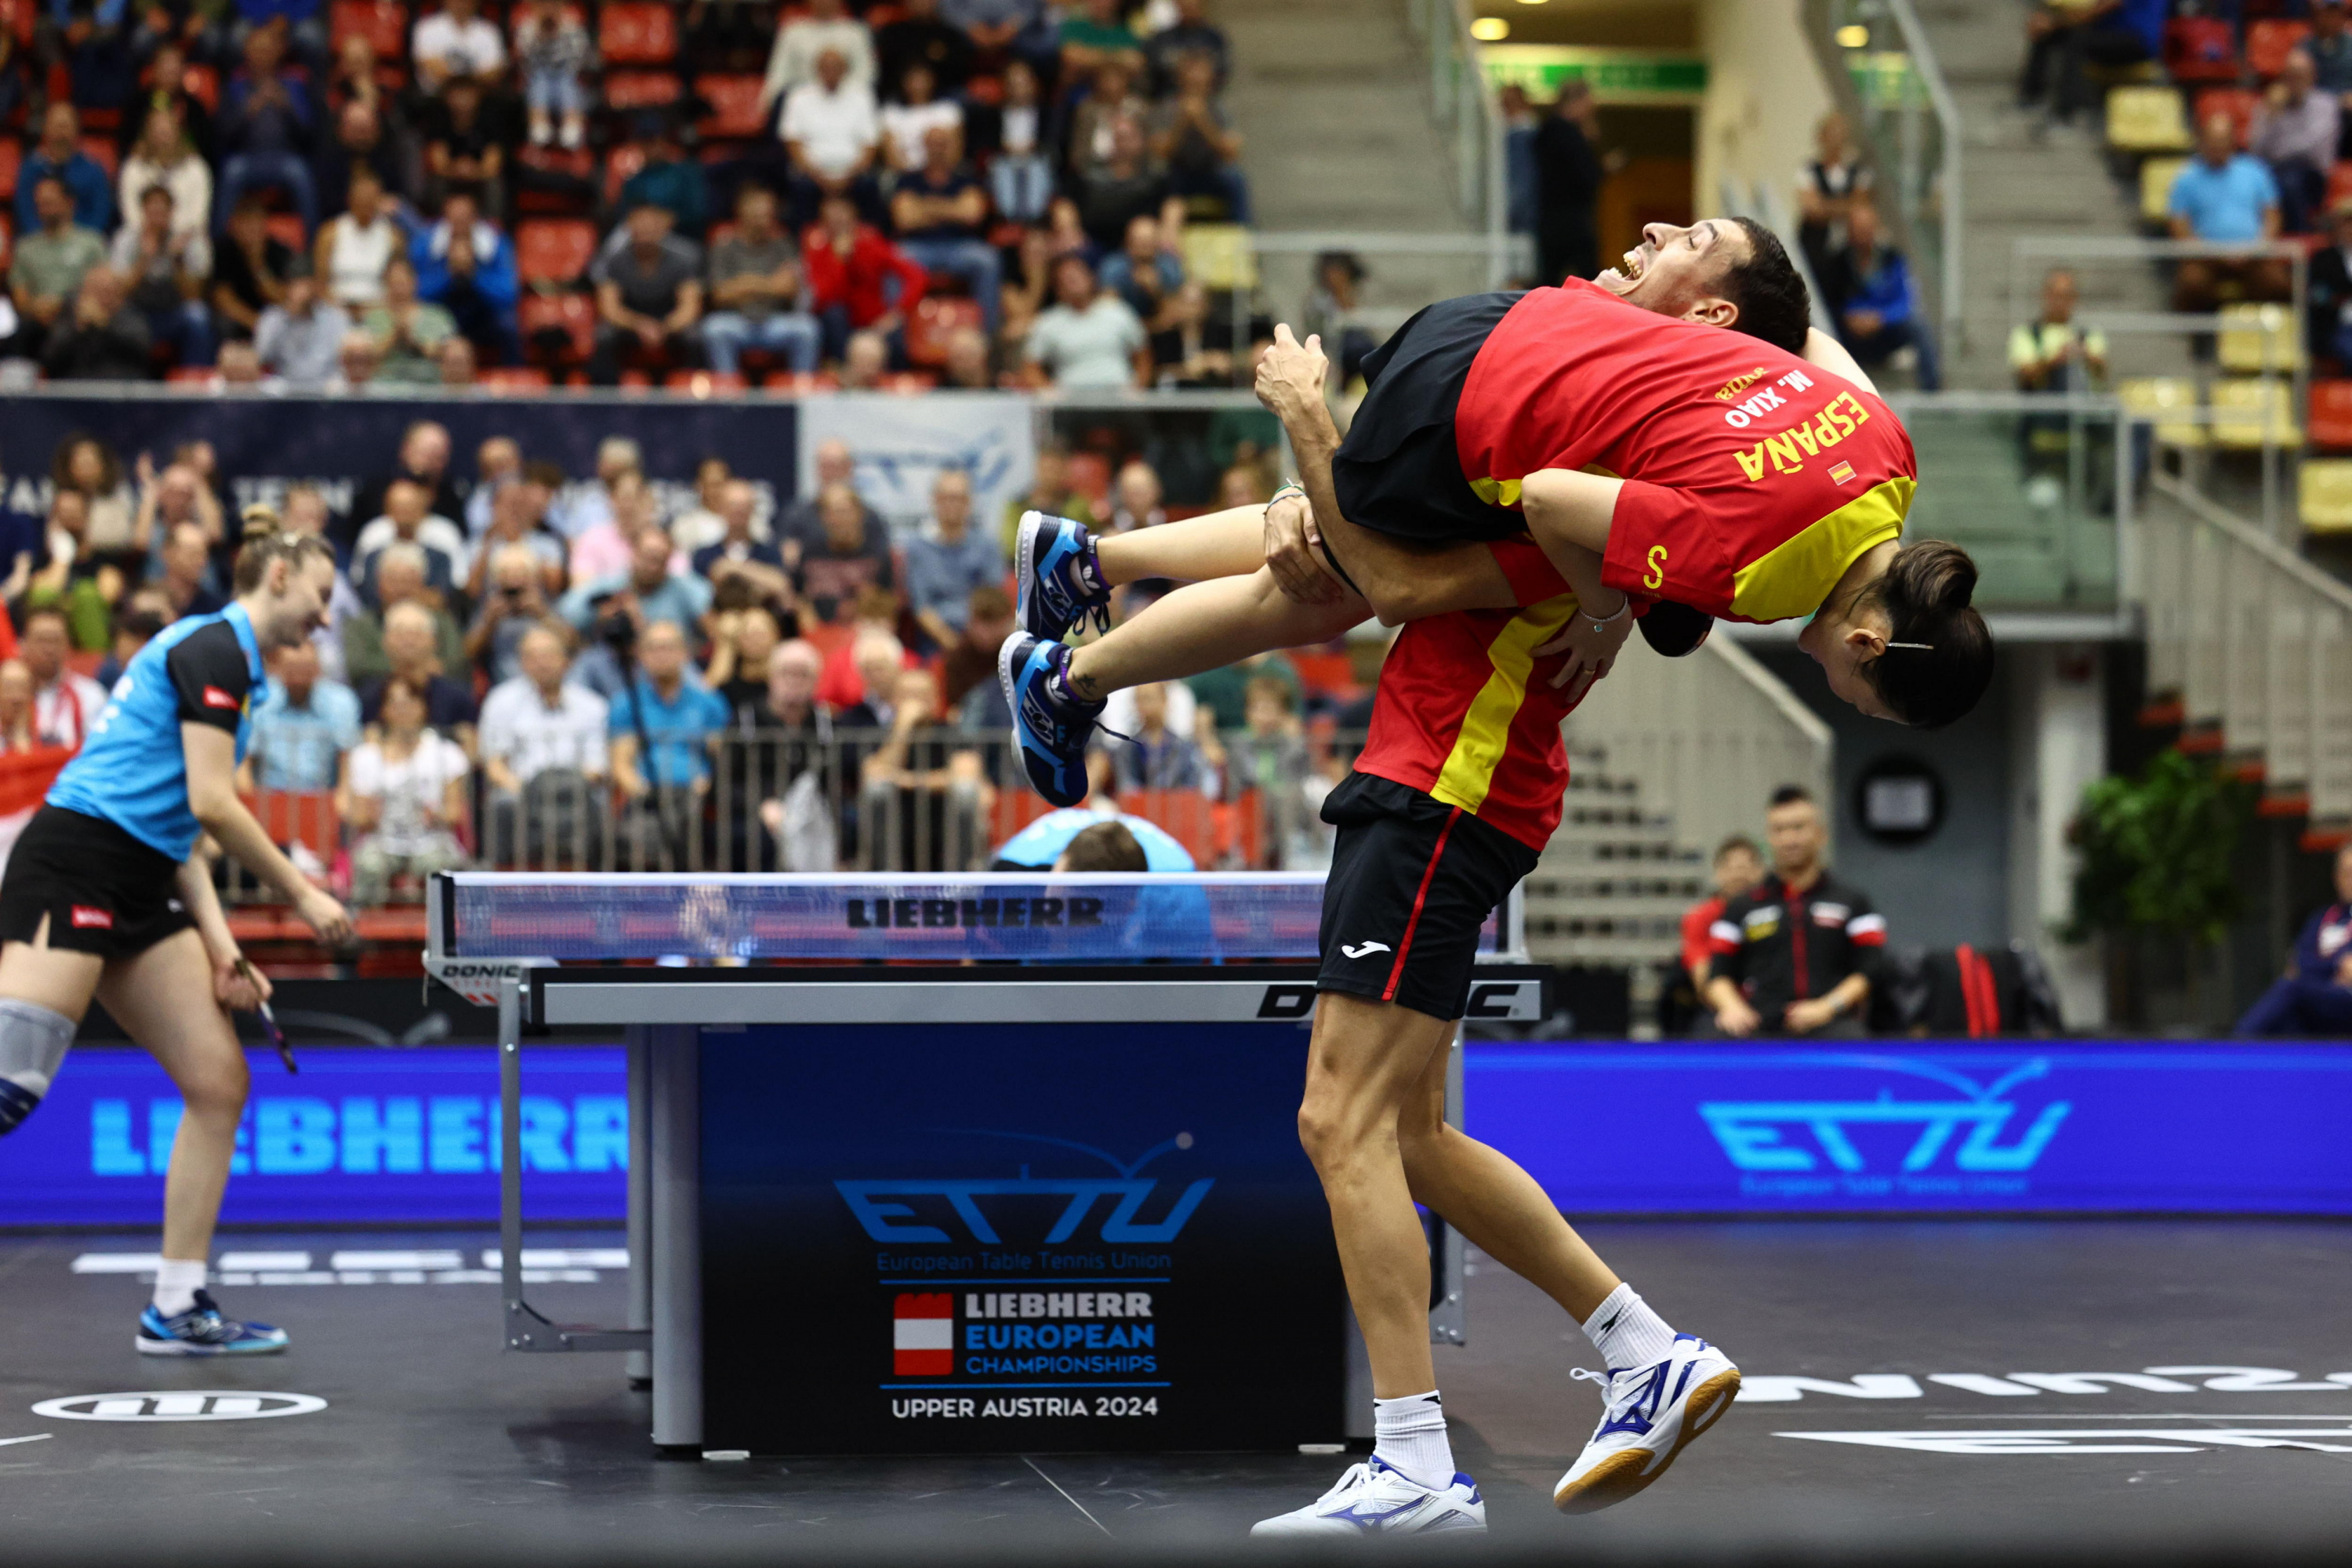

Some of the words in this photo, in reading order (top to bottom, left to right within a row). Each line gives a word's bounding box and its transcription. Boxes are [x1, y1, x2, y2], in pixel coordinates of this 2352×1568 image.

[1777, 369, 1814, 393] M.
[1725, 387, 1787, 428] XIAO
[1732, 390, 1870, 481] ESPAÑA
[847, 898, 1103, 928] LIEBHERR
[443, 965, 520, 978] DONIC
[1697, 1101, 2073, 1172] ETTU
[833, 1178, 1216, 1243] ETTU
[877, 1253, 974, 1273] European
[980, 1252, 1032, 1270] Table
[1038, 1250, 1105, 1270] Tennis
[1111, 1252, 1172, 1269] Union
[965, 1292, 1152, 1318] LIEBHERR
[965, 1323, 1155, 1350] EUROPEAN
[965, 1356, 1157, 1374] CHAMPIONSHIPS
[892, 1398, 975, 1417] UPPER
[982, 1398, 1089, 1417] AUSTRIA
[1095, 1396, 1158, 1416] 2024
